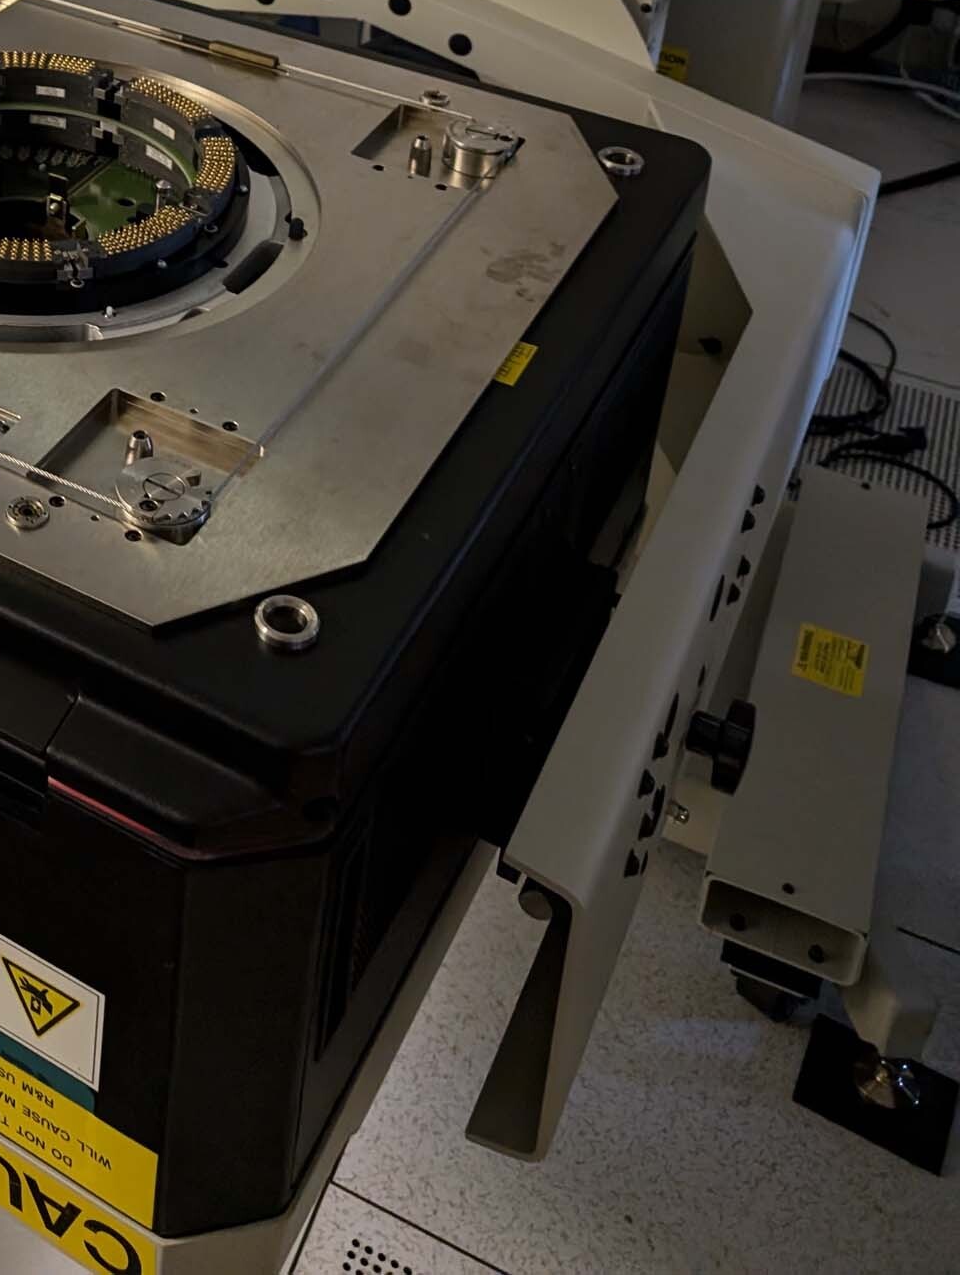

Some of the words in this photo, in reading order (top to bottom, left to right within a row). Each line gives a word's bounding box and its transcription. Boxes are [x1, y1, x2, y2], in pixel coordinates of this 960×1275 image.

[21, 1081, 55, 1109] R&M
[16, 1125, 46, 1150] NOT
[22, 1105, 71, 1142] CAUSE
[51, 1147, 73, 1168] DO
[76, 1138, 112, 1171] WILL
